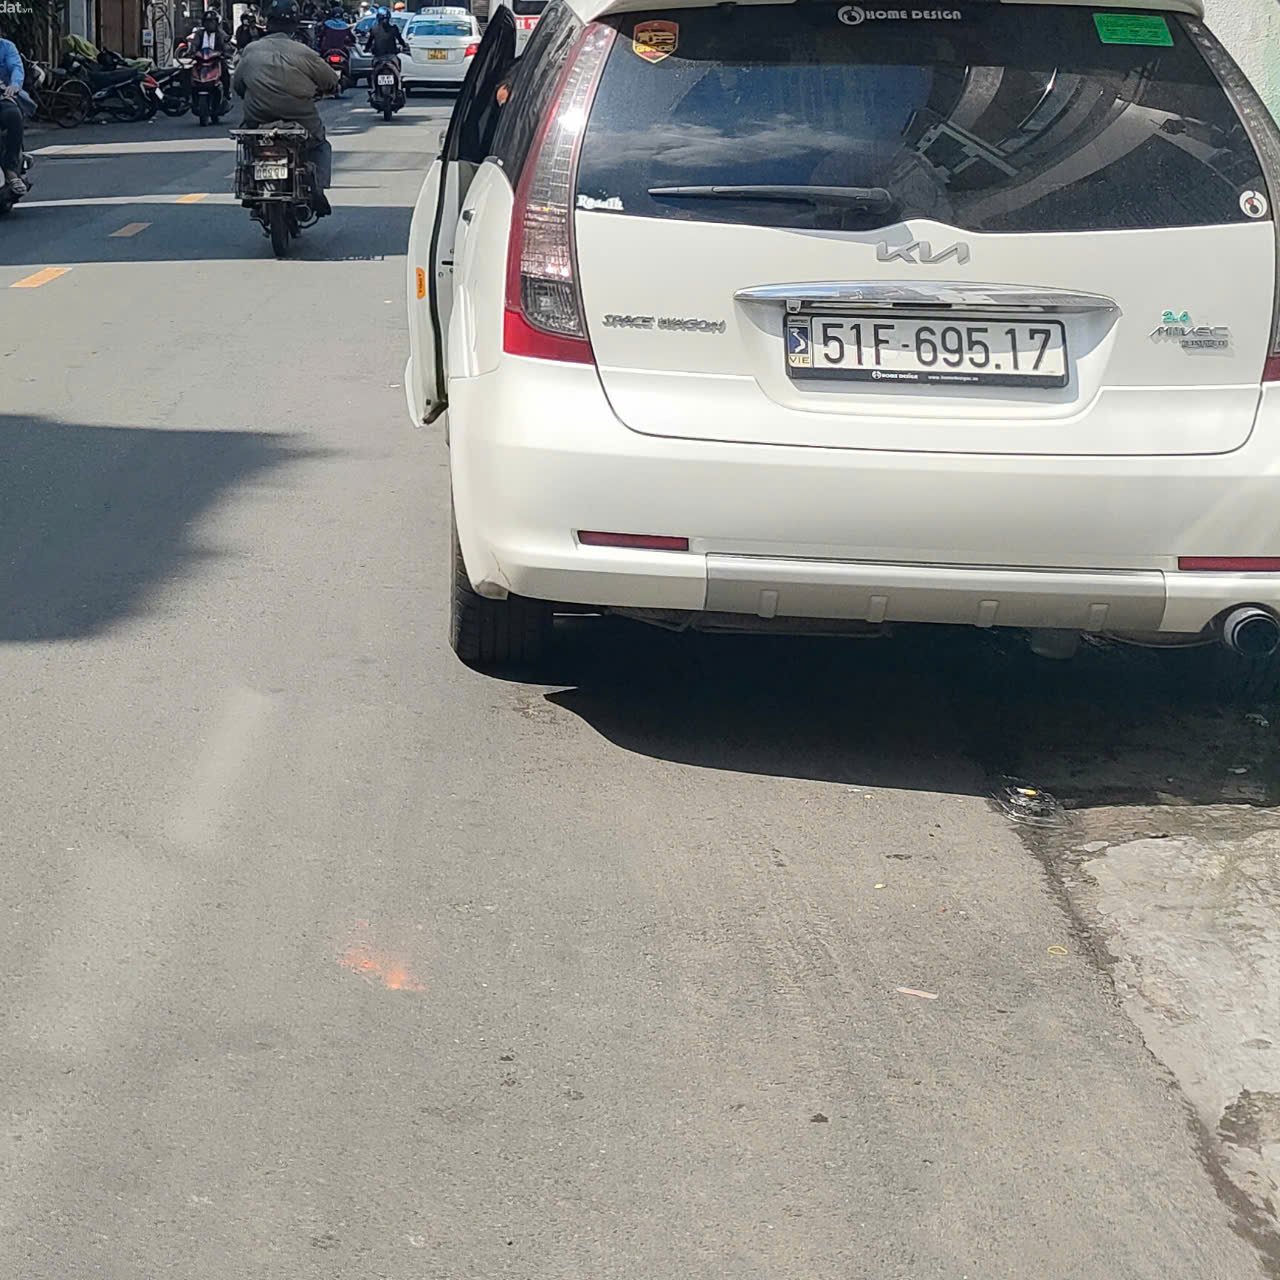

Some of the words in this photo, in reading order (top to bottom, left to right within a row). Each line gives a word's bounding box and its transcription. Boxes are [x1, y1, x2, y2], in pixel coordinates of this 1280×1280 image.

[865, 10, 908, 20] HOME
[911, 10, 962, 20] DESIGN
[602, 313, 656, 330] SPACE
[657, 316, 728, 334] WAGON
[821, 322, 1053, 372] 51F-695.17
[788, 355, 811, 366] VIE
